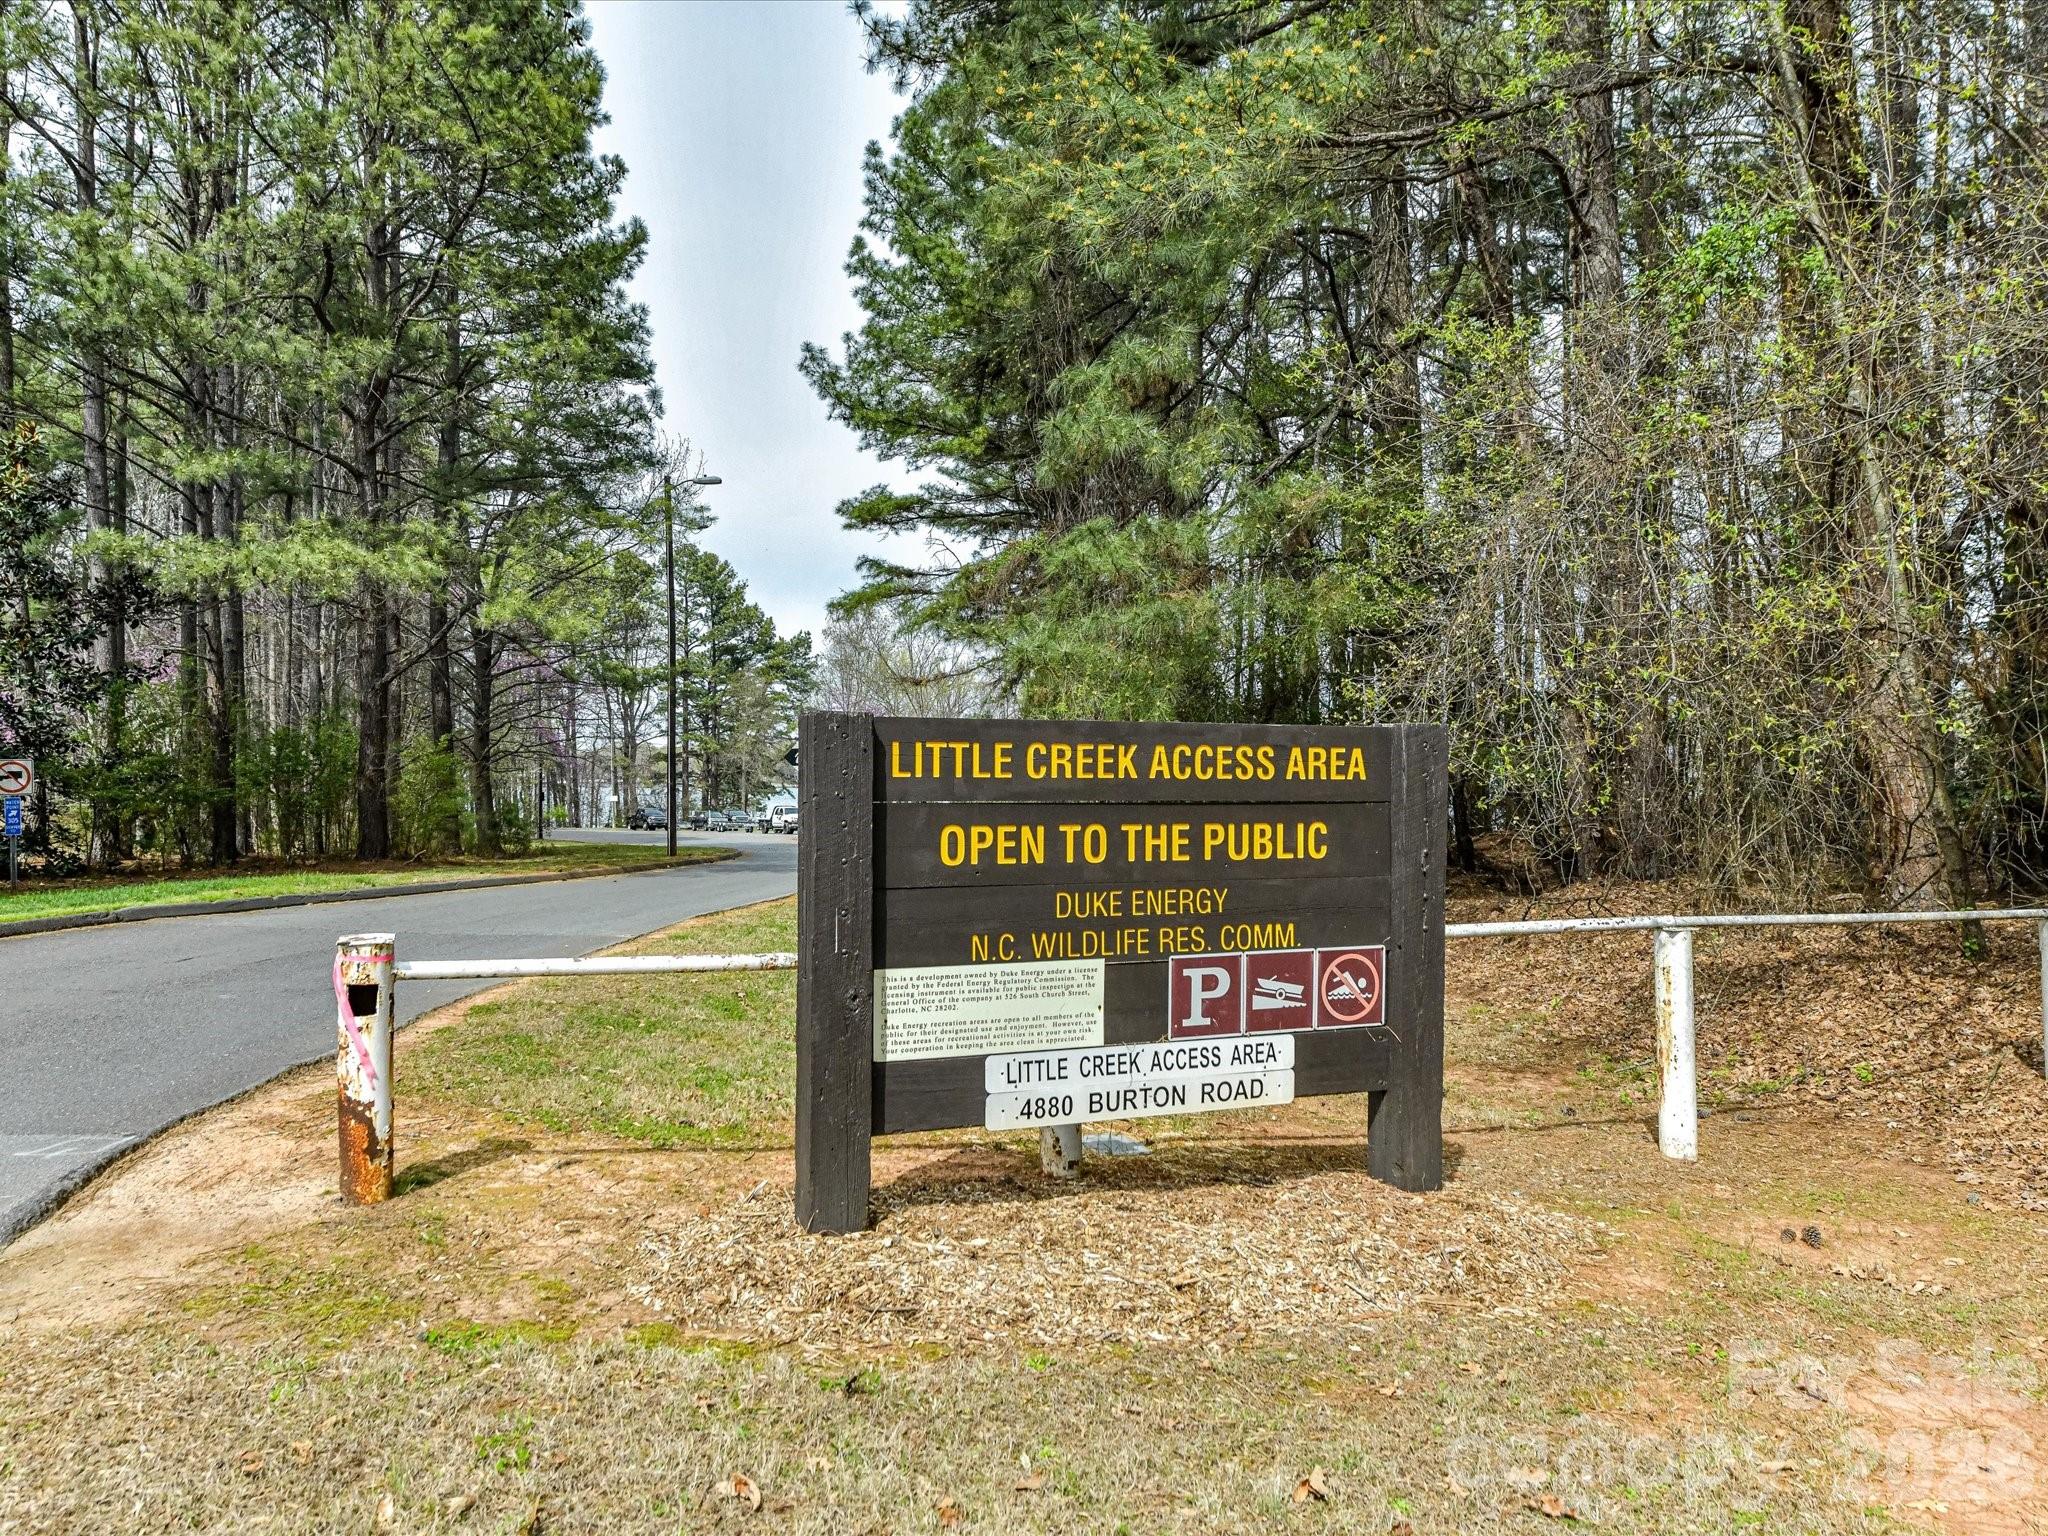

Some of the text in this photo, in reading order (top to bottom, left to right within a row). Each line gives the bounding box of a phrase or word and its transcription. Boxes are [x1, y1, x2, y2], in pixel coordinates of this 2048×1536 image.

[891, 742, 1367, 781] LITTLE CREEK ACCESS AREA
[939, 821, 1329, 867] OPEN TO THE PUBLIC
[1056, 888, 1228, 919] DUKE ENERGY
[971, 923, 1302, 962] N.C. WILDLIFE RES. COMM.
[881, 983, 908, 991] granted
[911, 982, 919, 990] by
[966, 979, 990, 988] Energy
[993, 977, 1031, 986] Regulatory
[1033, 975, 1077, 983] Commission.
[915, 973, 961, 982] development
[989, 971, 997, 979] by
[1020, 969, 1044, 977] Energy
[881, 991, 914, 1000] licensing
[917, 989, 956, 997] instrument
[967, 986, 999, 994] available
[1015, 985, 1036, 993] public
[1039, 983, 1074, 992] inspection
[912, 997, 935, 1005] Office
[1068, 989, 1089, 997] Street,
[1182, 967, 1231, 1027] P
[880, 1006, 918, 1015] Charlotte,
[880, 1031, 903, 1040] public
[939, 1026, 978, 1036] designated
[1009, 1022, 1047, 1031] enjoyment.
[1052, 1020, 1083, 1028] However,
[902, 1021, 927, 1030] Energy
[930, 1019, 967, 1027] recreation
[900, 1044, 943, 1054] cooperation
[955, 1041, 983, 1050] keeping
[1046, 1034, 1086, 1044] appreciated.
[947, 1033, 990, 1042] recreational
[992, 1031, 1025, 1039] activities
[1006, 1042, 1278, 1084] LITTLE CREEK ACCESS AREA
[1020, 1095, 1073, 1120] 4880
[1089, 1084, 1187, 1114] BURTON
